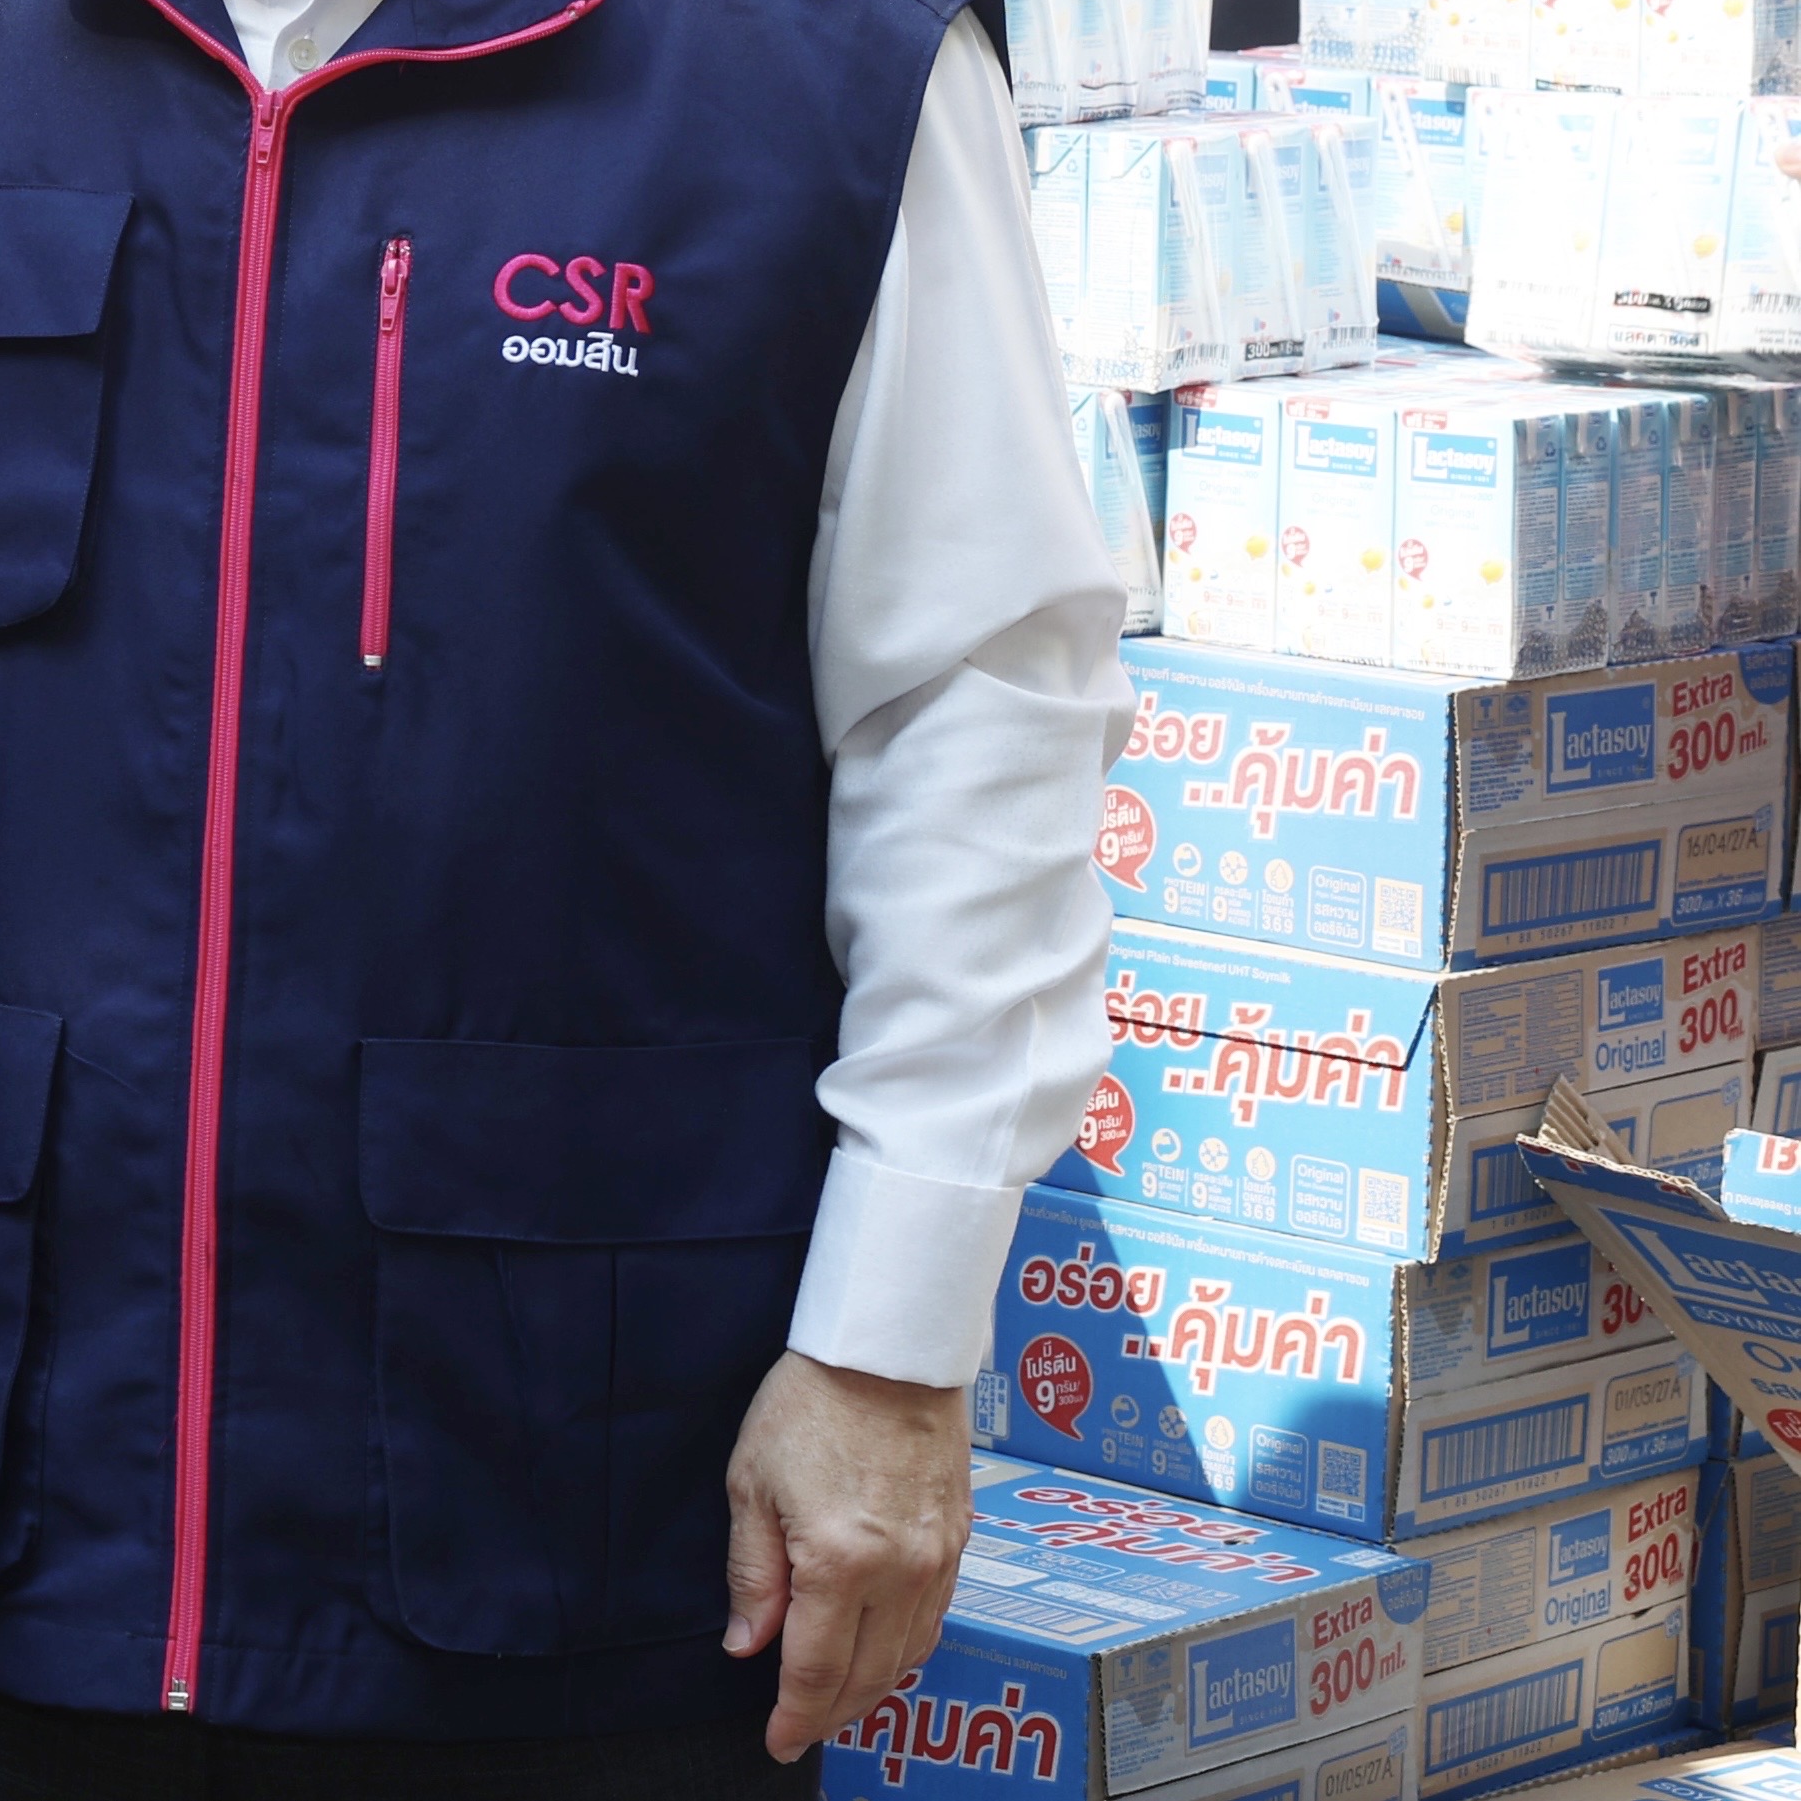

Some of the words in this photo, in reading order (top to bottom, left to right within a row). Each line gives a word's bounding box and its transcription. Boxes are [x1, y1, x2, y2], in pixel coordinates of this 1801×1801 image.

[493, 253, 655, 333] CSR
[502, 331, 639, 377] ออมสิน
[1184, 412, 1263, 456] Lactasoy
[1295, 425, 1378, 468] Lactasoy
[1413, 436, 1498, 480] Lactasoy
[1672, 672, 1734, 718] Extra
[1122, 694, 1226, 762] ร่อย
[1550, 711, 1652, 784] Lactasoy
[1667, 712, 1736, 780] 300
[1739, 719, 1767, 756] ml.
[1101, 833, 1119, 867] 9
[1164, 887, 1179, 914] 9
[1315, 873, 1361, 896] Original
[1212, 896, 1228, 922] 9
[1314, 902, 1360, 922] รสหวาน
[1146, 950, 1171, 967] Plain
[1172, 954, 1227, 975] Sweetened
[1227, 962, 1250, 978] UHT
[1251, 965, 1292, 985] Soymilk
[1682, 942, 1747, 996] Extra
[1104, 973, 1203, 1045] ร่อย
[1599, 979, 1662, 1026] Lactasoy
[1679, 988, 1739, 1053] 300
[1595, 1029, 1666, 1072] Original
[1080, 1118, 1098, 1149] 9
[1142, 1172, 1157, 1198] 9
[1192, 1182, 1208, 1209] 9
[1298, 1164, 1345, 1185] Original
[1296, 1192, 1344, 1212] รสหวาน
[1022, 1244, 1164, 1315] อร่อย
[1625, 1224, 1801, 1306] Lacta
[1492, 1276, 1588, 1348] Lactasoy
[1602, 1283, 1646, 1335] 30
[1036, 1380, 1056, 1414] 9
[1102, 1437, 1118, 1464] 9
[1152, 1449, 1168, 1476] 9
[1256, 1432, 1303, 1455] Original
[1255, 1461, 1302, 1483] รสหวาน
[1015, 1487, 1269, 1543] อร่อย
[1627, 1485, 1689, 1544] Extra
[1549, 1533, 1610, 1580] Lactasoy
[1623, 1532, 1680, 1602] 300
[1313, 1597, 1374, 1650] Extra
[1545, 1580, 1612, 1626] Original
[1193, 1659, 1293, 1739] Lactasoy
[1310, 1637, 1376, 1716] 300
[1379, 1641, 1406, 1681] ml.
